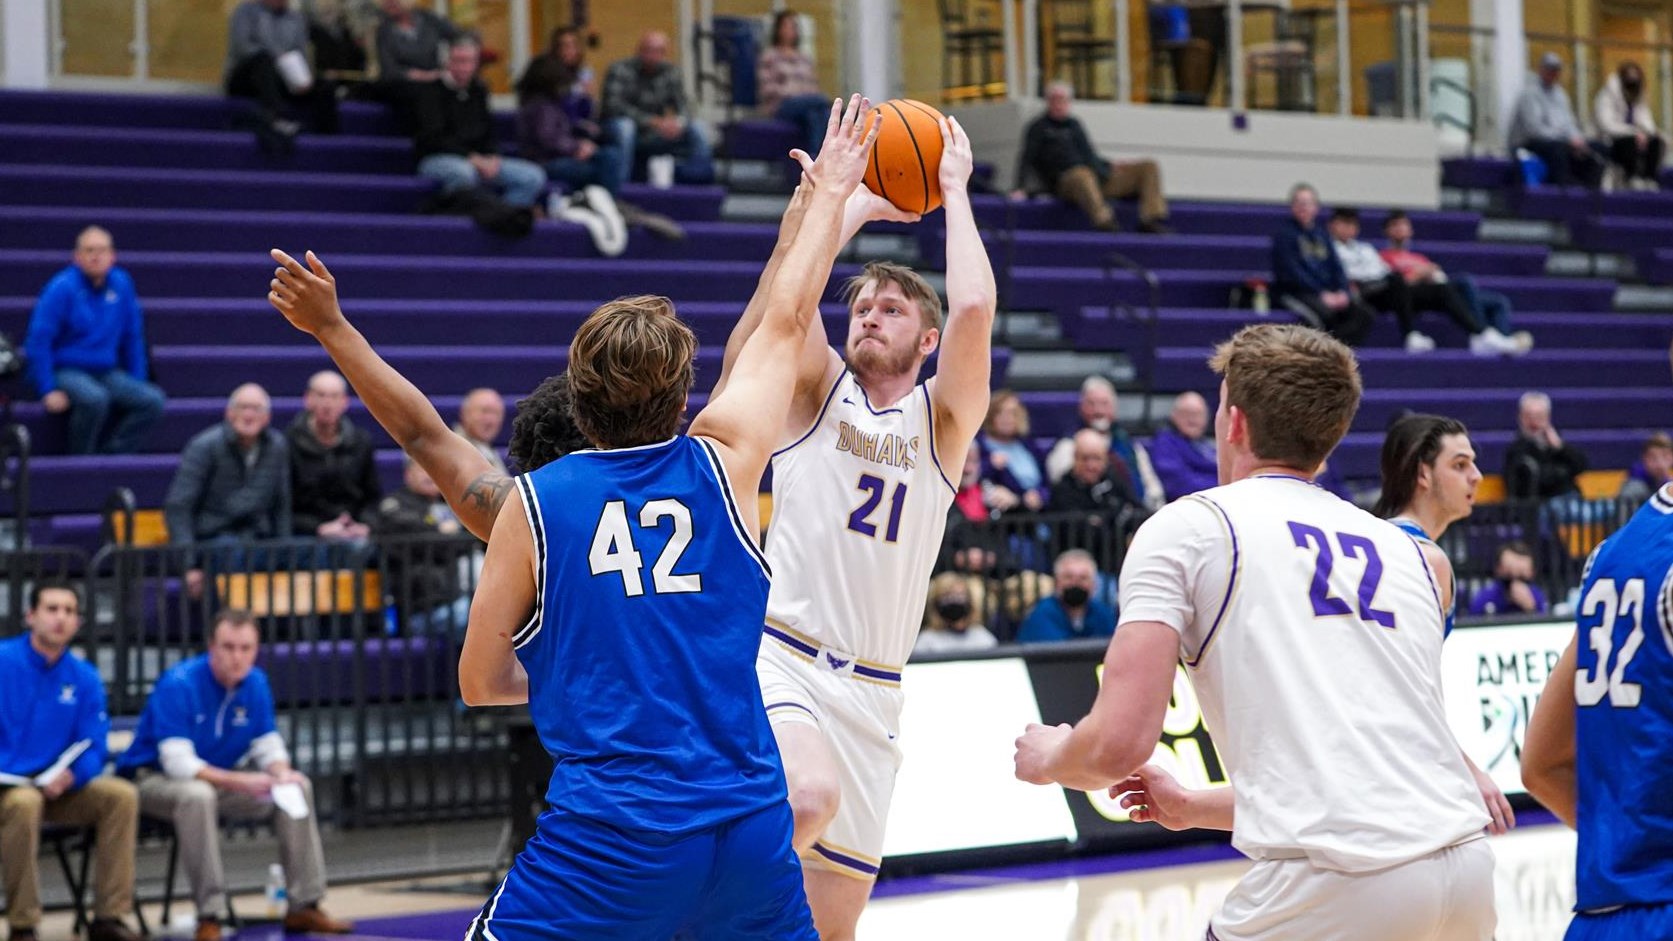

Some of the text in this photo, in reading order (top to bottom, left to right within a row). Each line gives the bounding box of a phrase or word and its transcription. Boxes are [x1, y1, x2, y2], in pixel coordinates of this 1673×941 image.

[588, 497, 702, 598] 42
[846, 472, 909, 544] 21
[1286, 520, 1397, 629] 22
[1574, 577, 1645, 707] 32
